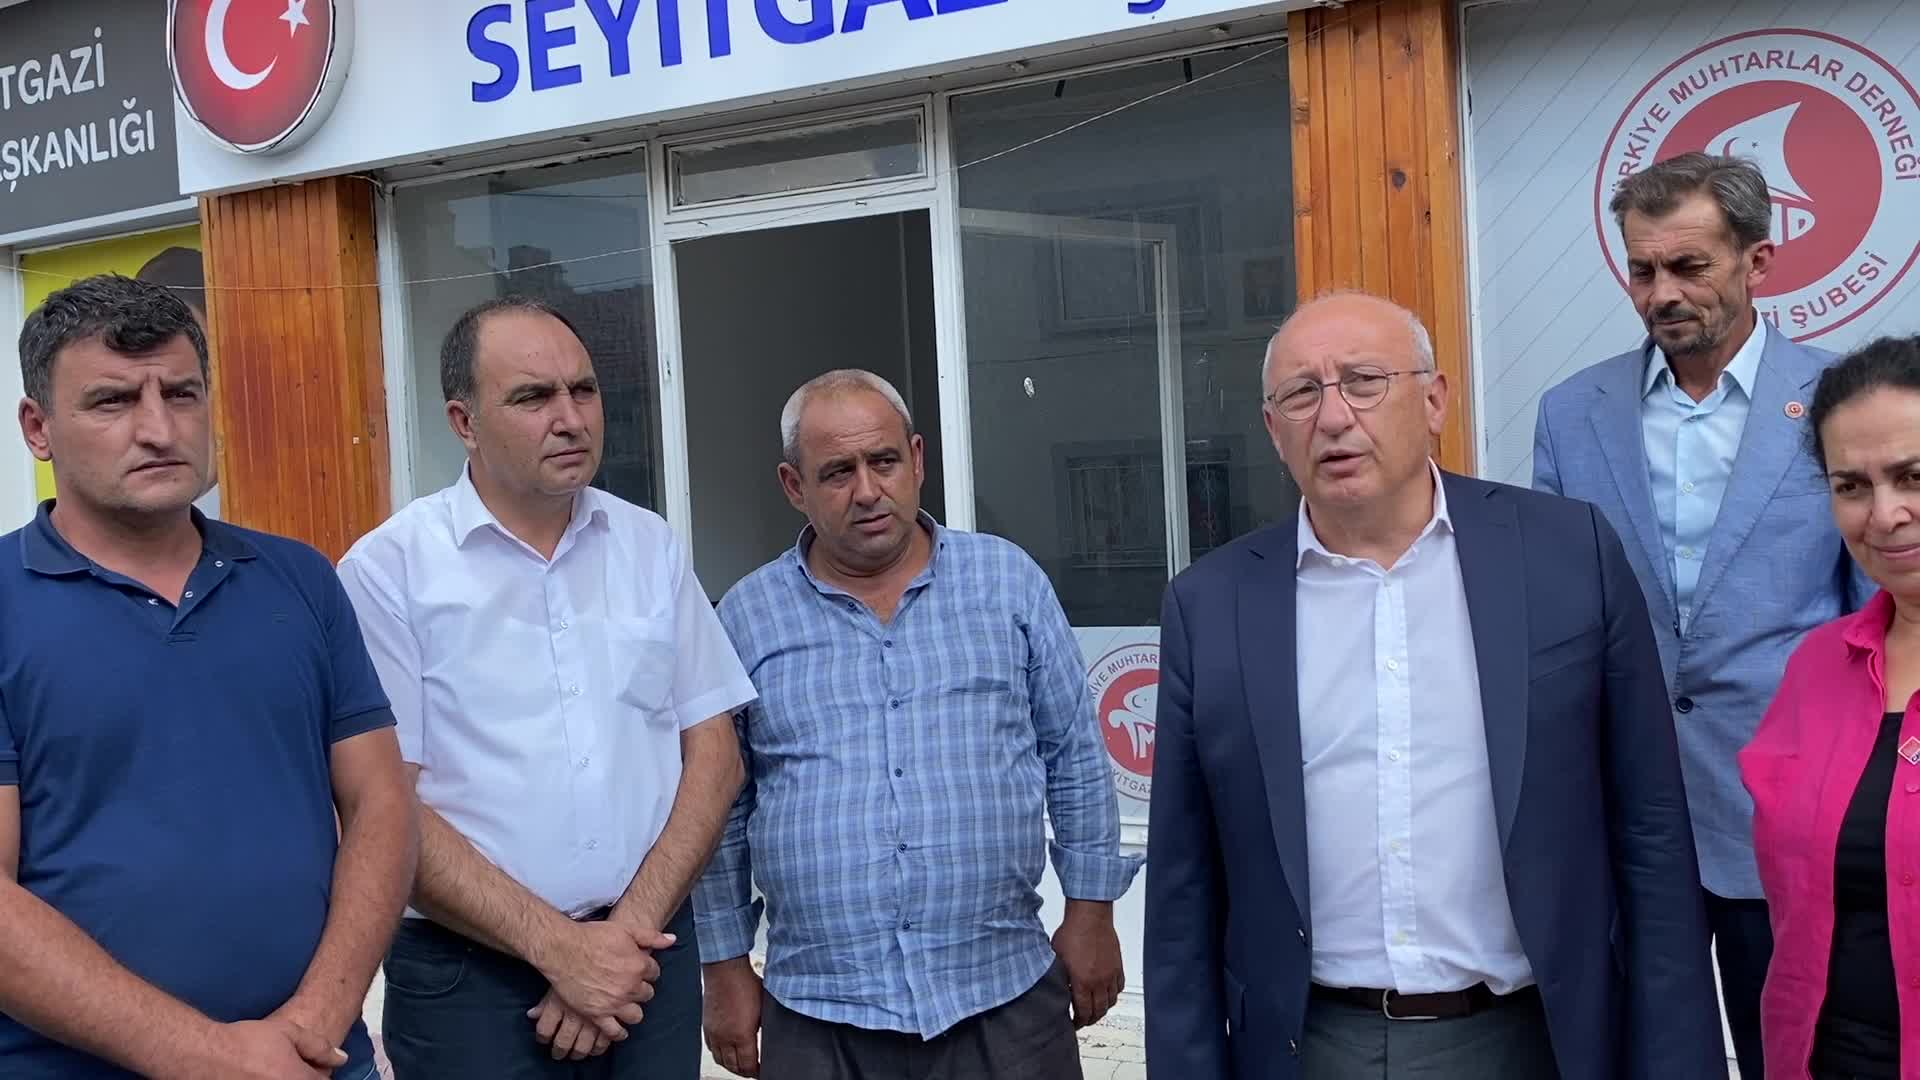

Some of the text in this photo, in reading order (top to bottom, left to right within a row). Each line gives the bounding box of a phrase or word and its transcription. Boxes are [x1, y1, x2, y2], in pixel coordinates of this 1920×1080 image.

[0, 97, 155, 192] ŞKANLIĞI
[1611, 102, 1671, 192] RKİYE
[1668, 49, 1844, 105] MUHTARLAR
[1789, 250, 1888, 329] ŞUBESİ
